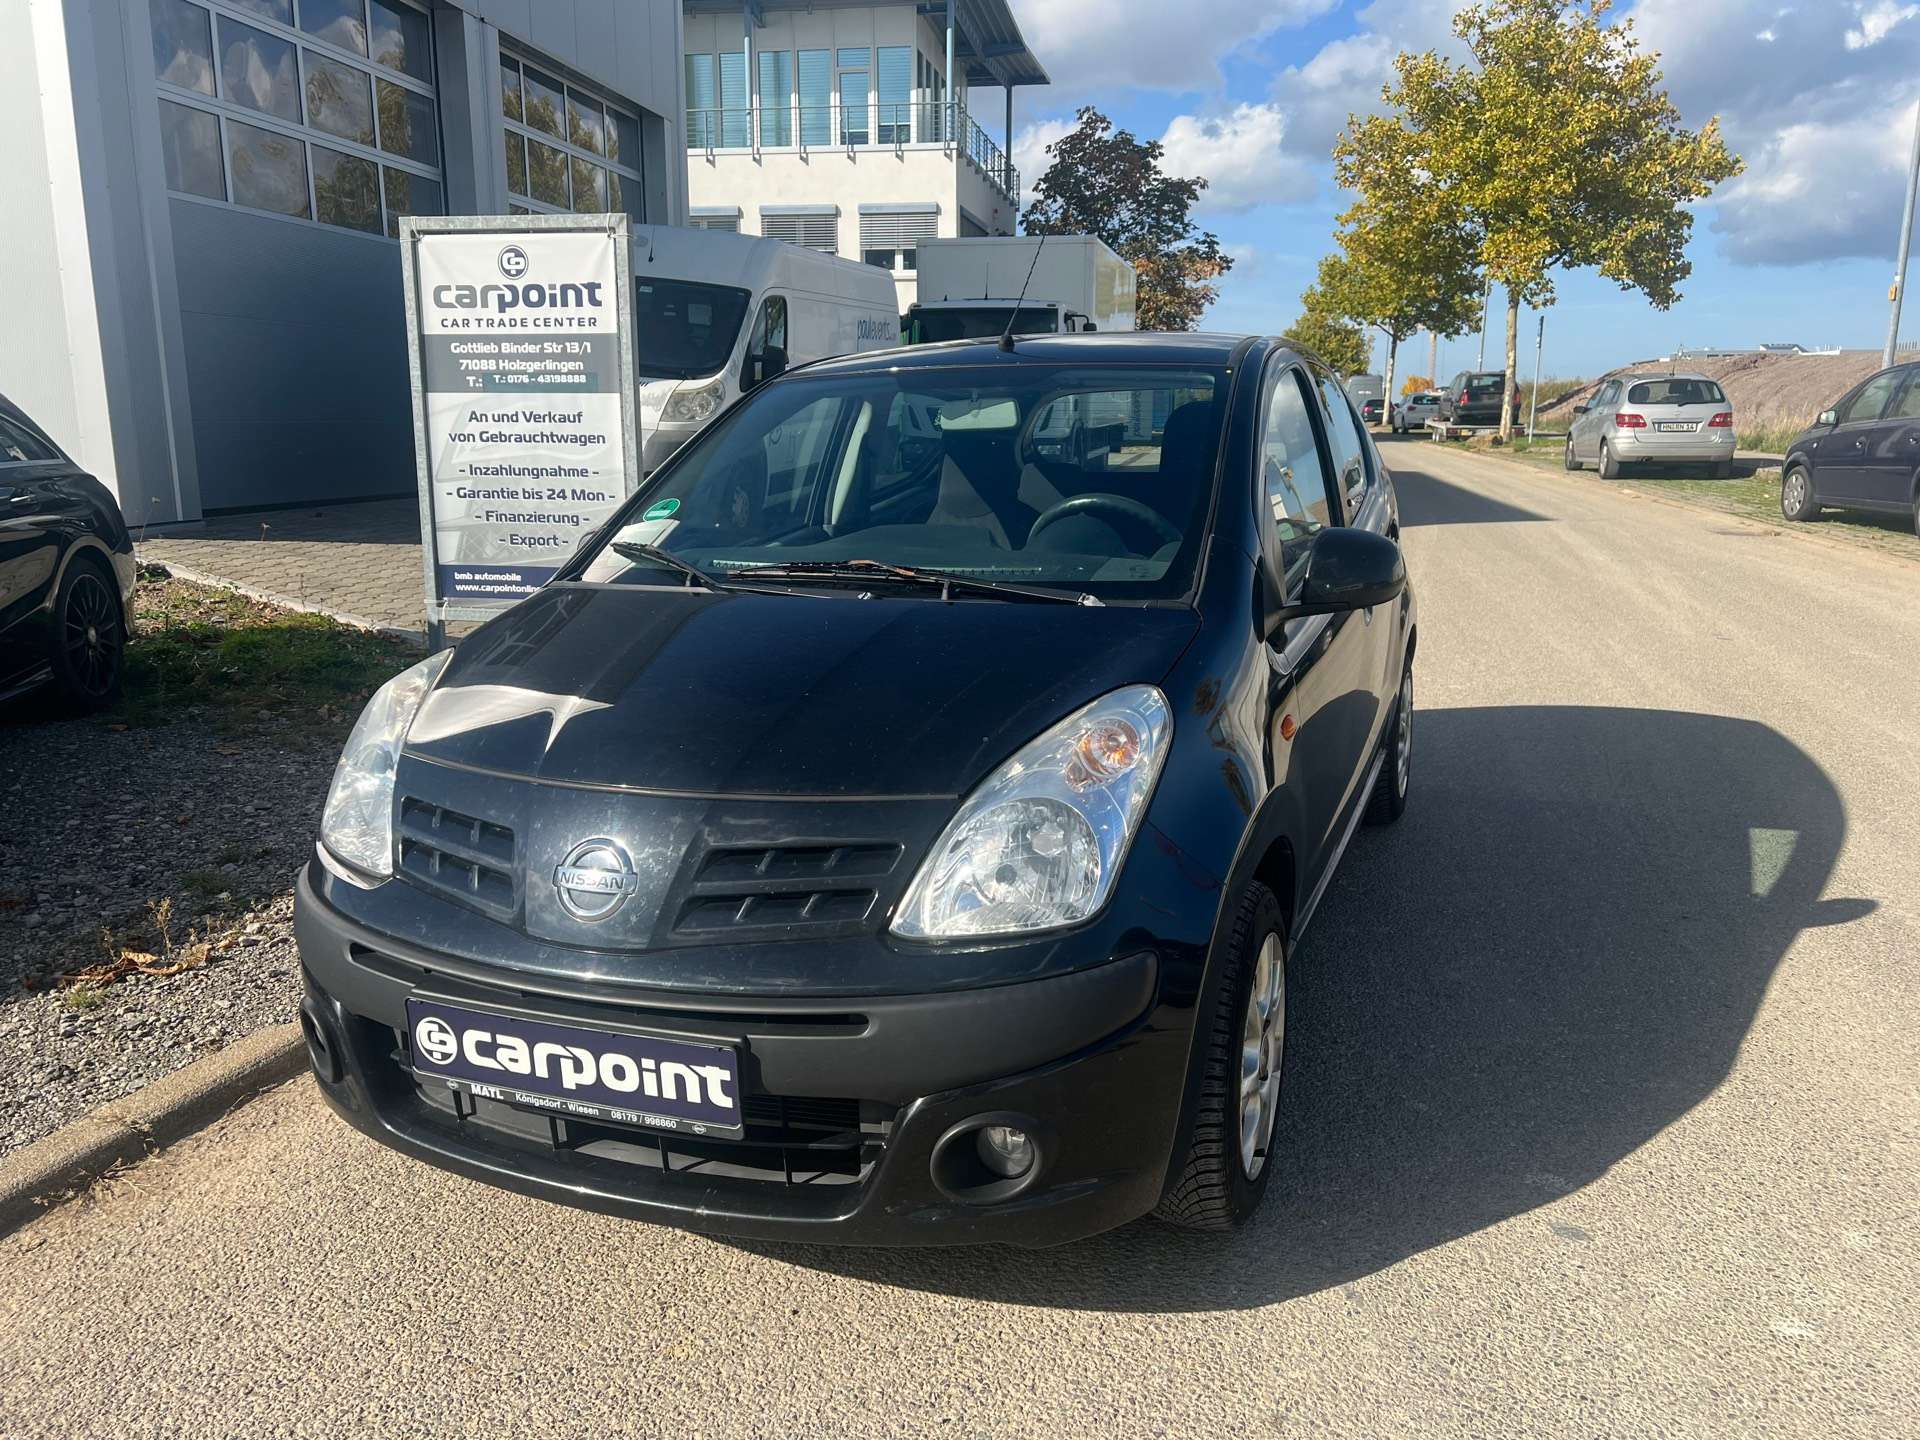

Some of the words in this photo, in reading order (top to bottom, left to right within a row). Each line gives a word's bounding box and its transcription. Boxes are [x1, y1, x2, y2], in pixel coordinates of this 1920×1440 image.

[432, 281, 603, 314] carpoint
[440, 317, 471, 329] CAR
[477, 317, 529, 328] TRADE
[532, 316, 598, 327] CENTER
[450, 341, 499, 355] Gottlieb
[500, 341, 541, 354] Binder
[543, 341, 564, 354] Str
[566, 341, 592, 356] 13/1
[458, 359, 497, 371] 71088
[498, 359, 584, 373] Holzgerlingen
[507, 374, 530, 384] 0176
[468, 410, 489, 423] An
[492, 410, 519, 424] und
[521, 411, 584, 424] Verkauf
[449, 431, 477, 443] von
[479, 430, 607, 447] Gebrauchtwagen
[469, 463, 590, 480] Inzahlungnahme
[456, 486, 520, 500] Garantie
[521, 486, 545, 500] bis
[546, 488, 568, 501] 24
[571, 489, 606, 501] Mon
[485, 510, 580, 526] Finanzierung
[509, 533, 560, 548] Export
[454, 572, 473, 580] bmb
[474, 573, 522, 581] automobile
[560, 871, 624, 890] NISSAN
[462, 1029, 733, 1109] carpoint
[471, 1083, 504, 1100] MATL
[515, 1092, 561, 1109] Königsdorf
[567, 1102, 599, 1116] Wiesen
